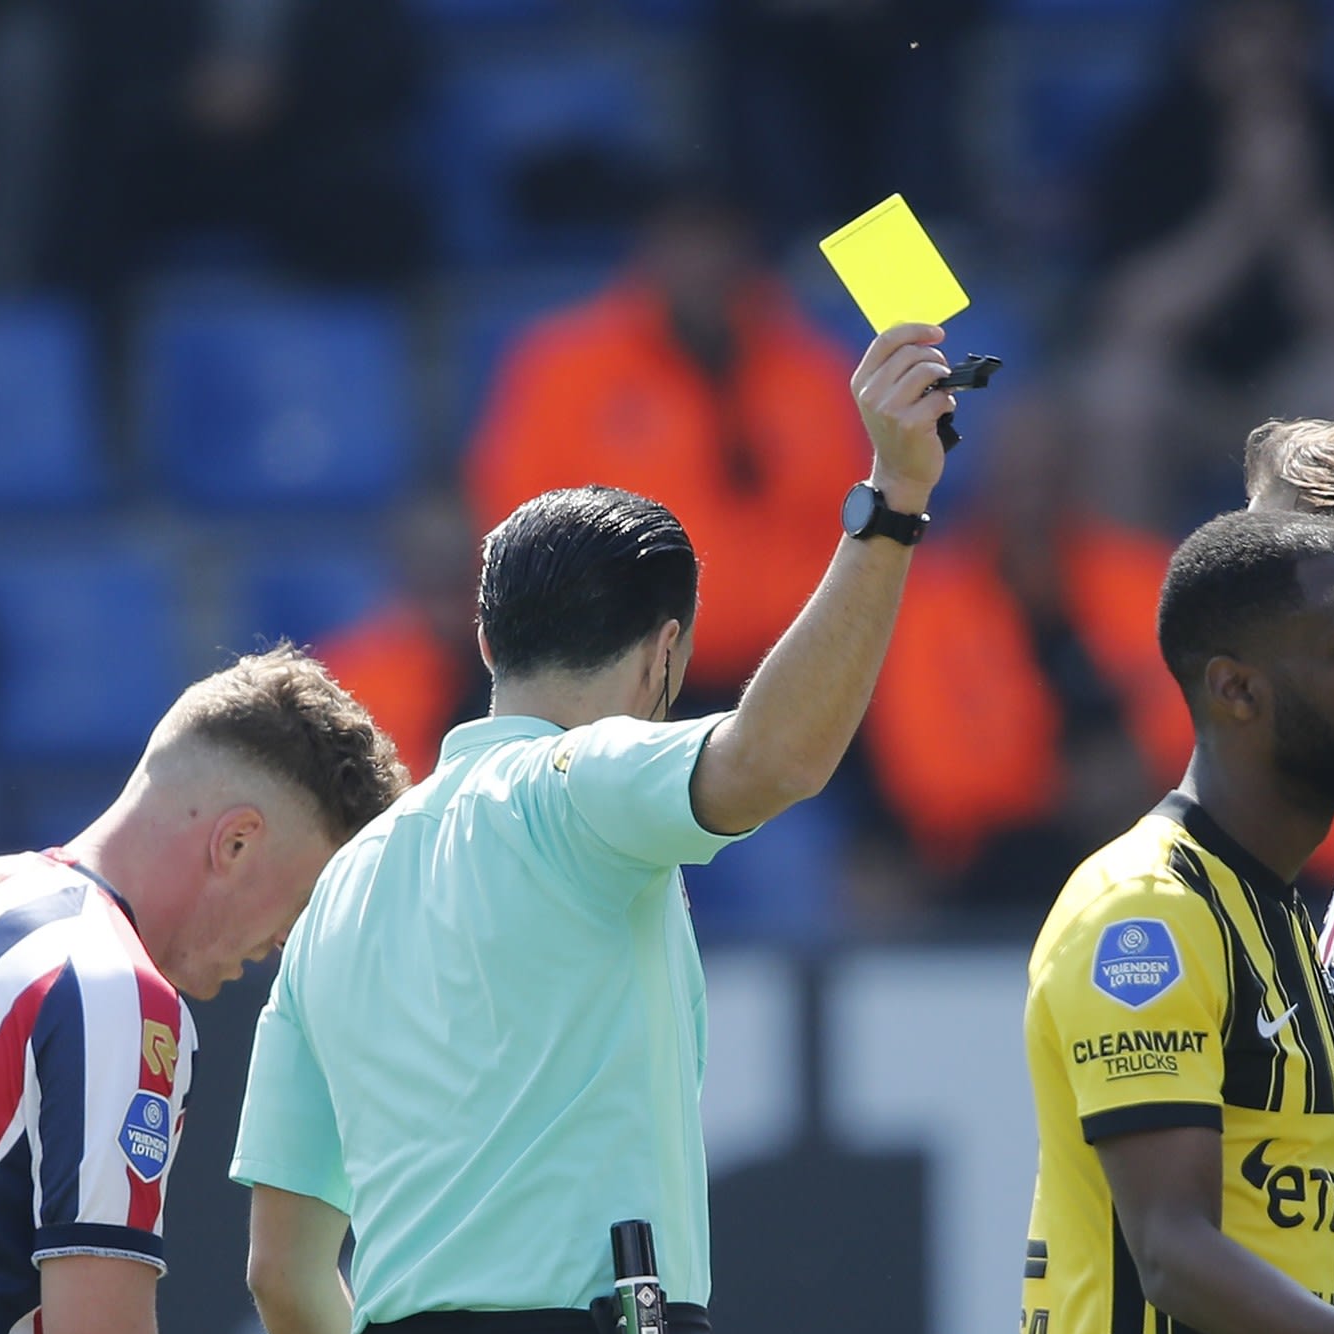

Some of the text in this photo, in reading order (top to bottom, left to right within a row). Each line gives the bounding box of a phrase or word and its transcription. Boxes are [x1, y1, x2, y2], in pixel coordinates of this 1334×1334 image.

[1102, 961, 1170, 976] VRIENDEN
[1110, 974, 1161, 988] LOTERIJ
[1072, 1029, 1209, 1065] CLEANMAT
[1103, 1052, 1178, 1076] TRUCKS
